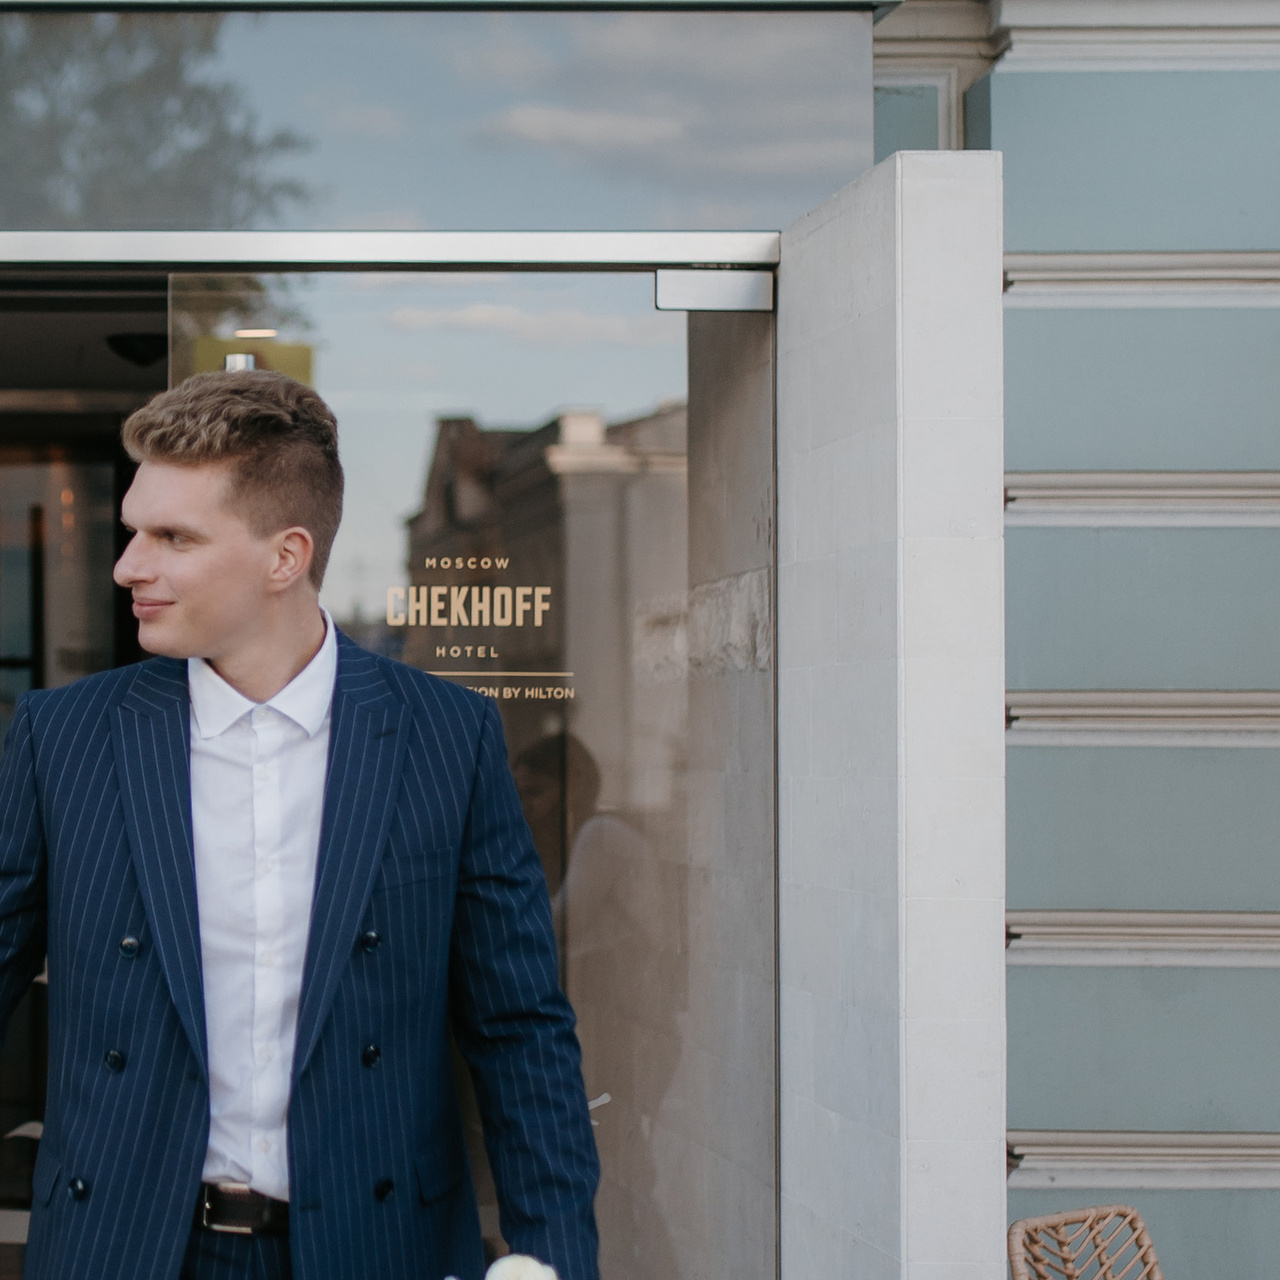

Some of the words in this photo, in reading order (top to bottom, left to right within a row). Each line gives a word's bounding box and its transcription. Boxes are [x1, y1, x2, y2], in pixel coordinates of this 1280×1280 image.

[425, 557, 510, 570] MOSCOW
[386, 585, 552, 627] CHEKHOFF
[435, 646, 499, 658] HOTEL
[502, 686, 521, 699] BY
[524, 686, 575, 699] HILTON
